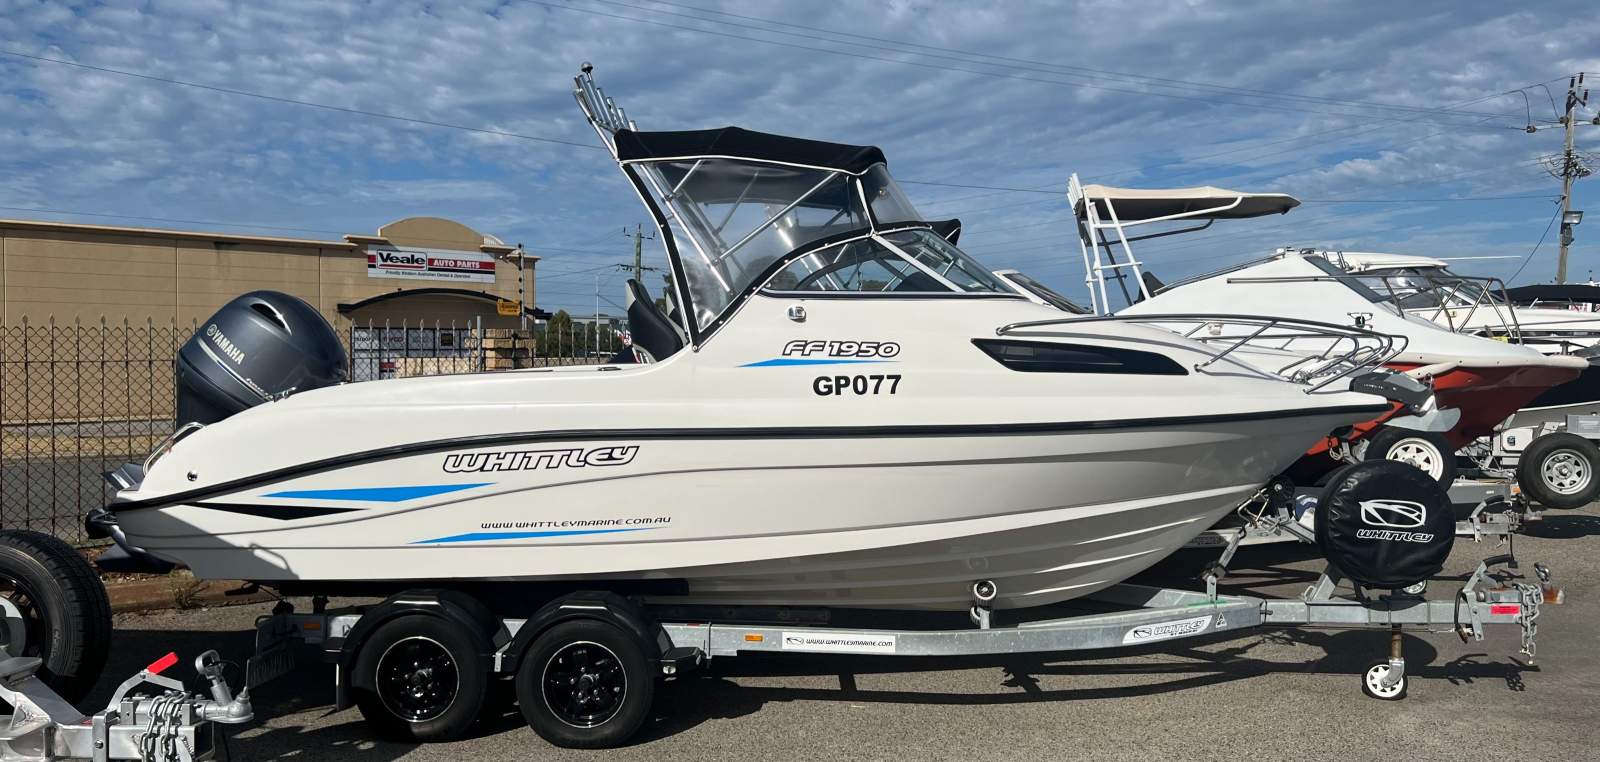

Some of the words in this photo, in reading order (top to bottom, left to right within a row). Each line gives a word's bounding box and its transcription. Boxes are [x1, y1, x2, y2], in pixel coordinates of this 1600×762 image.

[378, 252, 426, 265] Veale
[433, 259, 455, 268] AUTO
[457, 261, 480, 269] PARTS
[212, 329, 246, 365] YAMAHA
[812, 374, 902, 396] GP077
[443, 446, 640, 473] WHITTLEY
[1356, 528, 1434, 543] WHITTLEY
